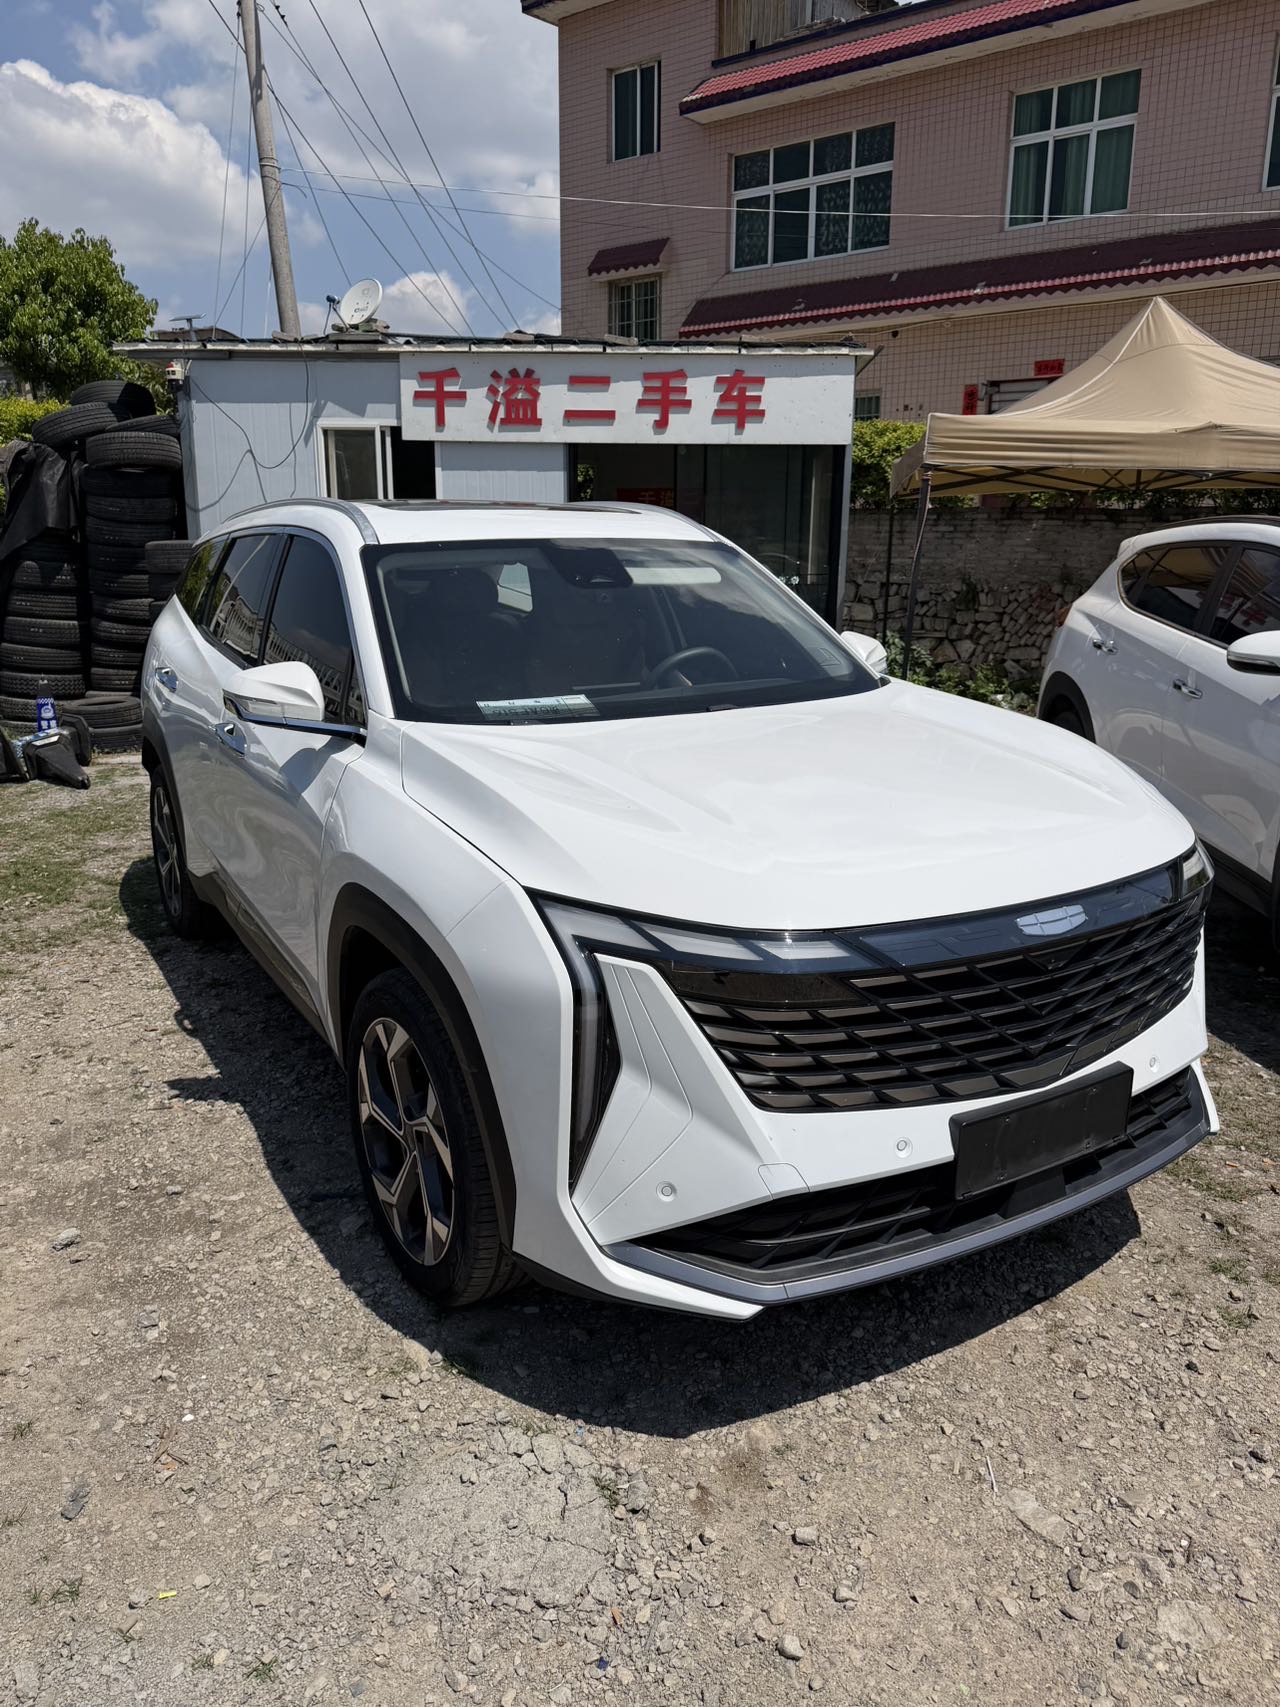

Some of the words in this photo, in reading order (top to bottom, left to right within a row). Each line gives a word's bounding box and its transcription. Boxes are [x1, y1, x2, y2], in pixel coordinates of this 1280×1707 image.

[413, 367, 766, 430] 千溢二手车
